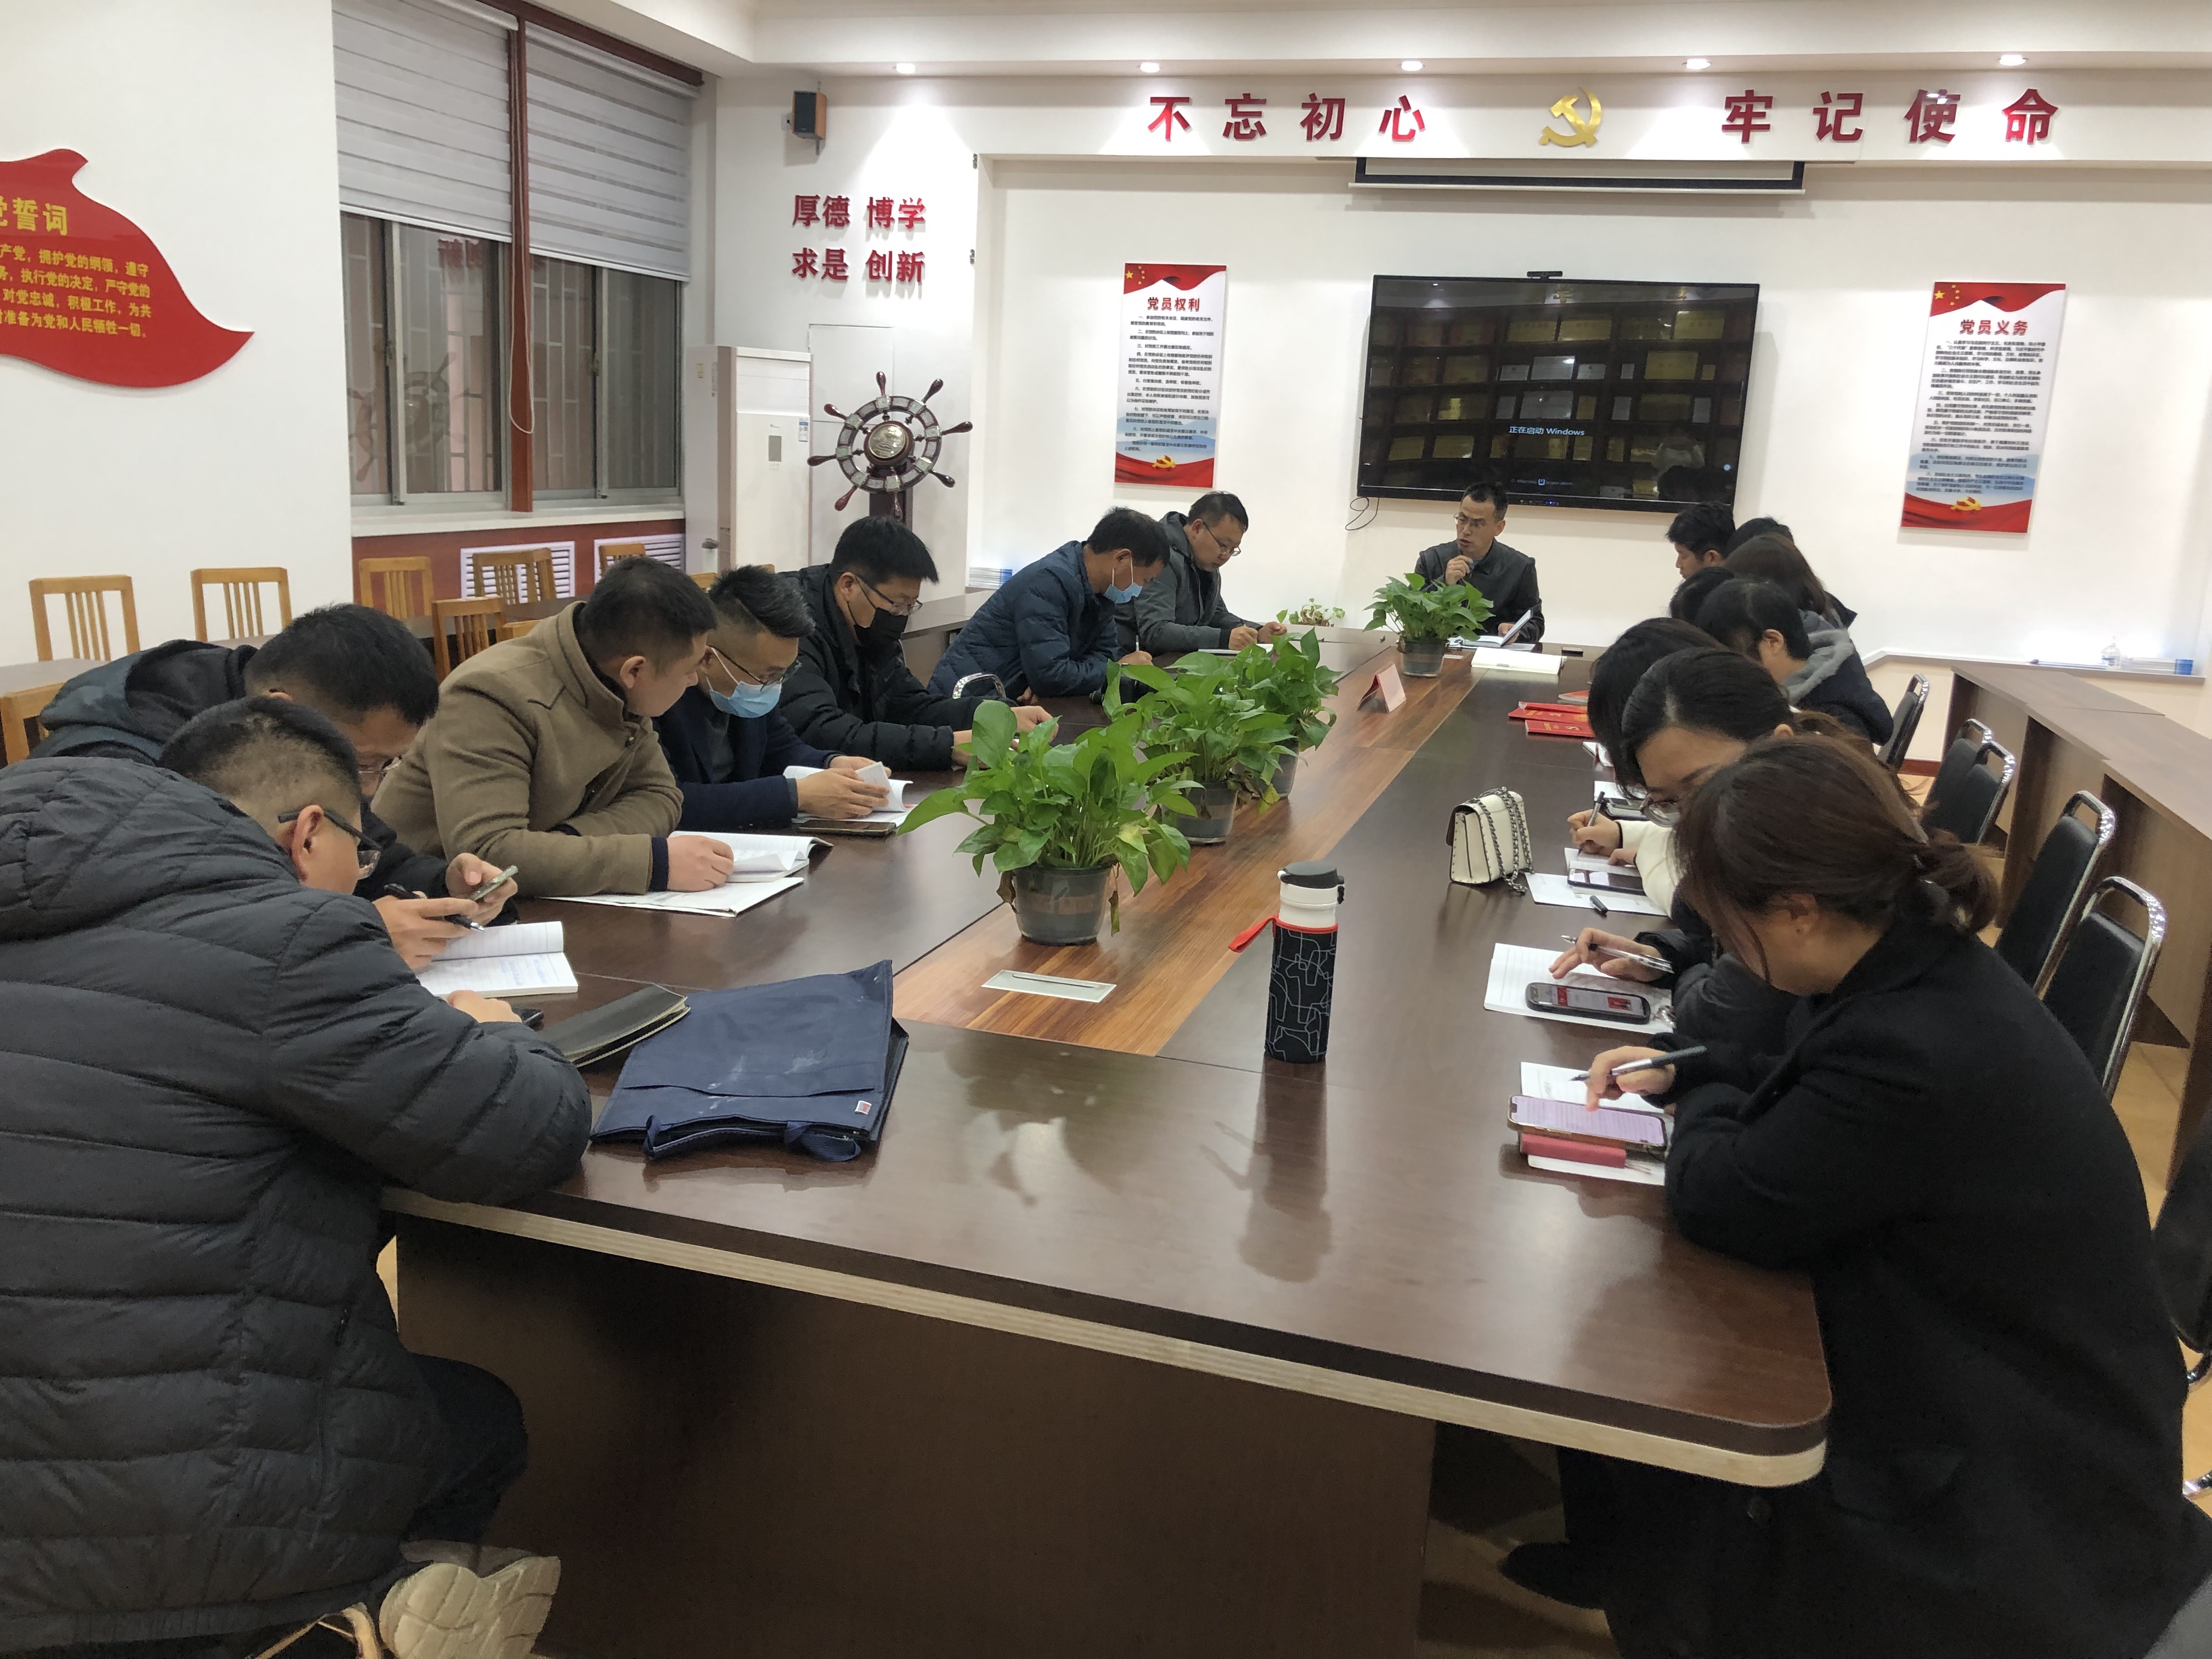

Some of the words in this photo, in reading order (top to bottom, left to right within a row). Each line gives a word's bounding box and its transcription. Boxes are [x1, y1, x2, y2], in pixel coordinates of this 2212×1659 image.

[1148, 93, 1425, 141] 不忘初心
[1722, 89, 2058, 144] 牢记使命
[793, 194, 850, 227] 厚德
[867, 196, 926, 229] 博学
[792, 247, 849, 281] 求是
[866, 250, 925, 283] 创新
[1147, 297, 1200, 311] 党员权利
[1960, 319, 2028, 335] 党员义务
[1509, 426, 1544, 435] 正在启动
[1546, 427, 1585, 436] Windows
